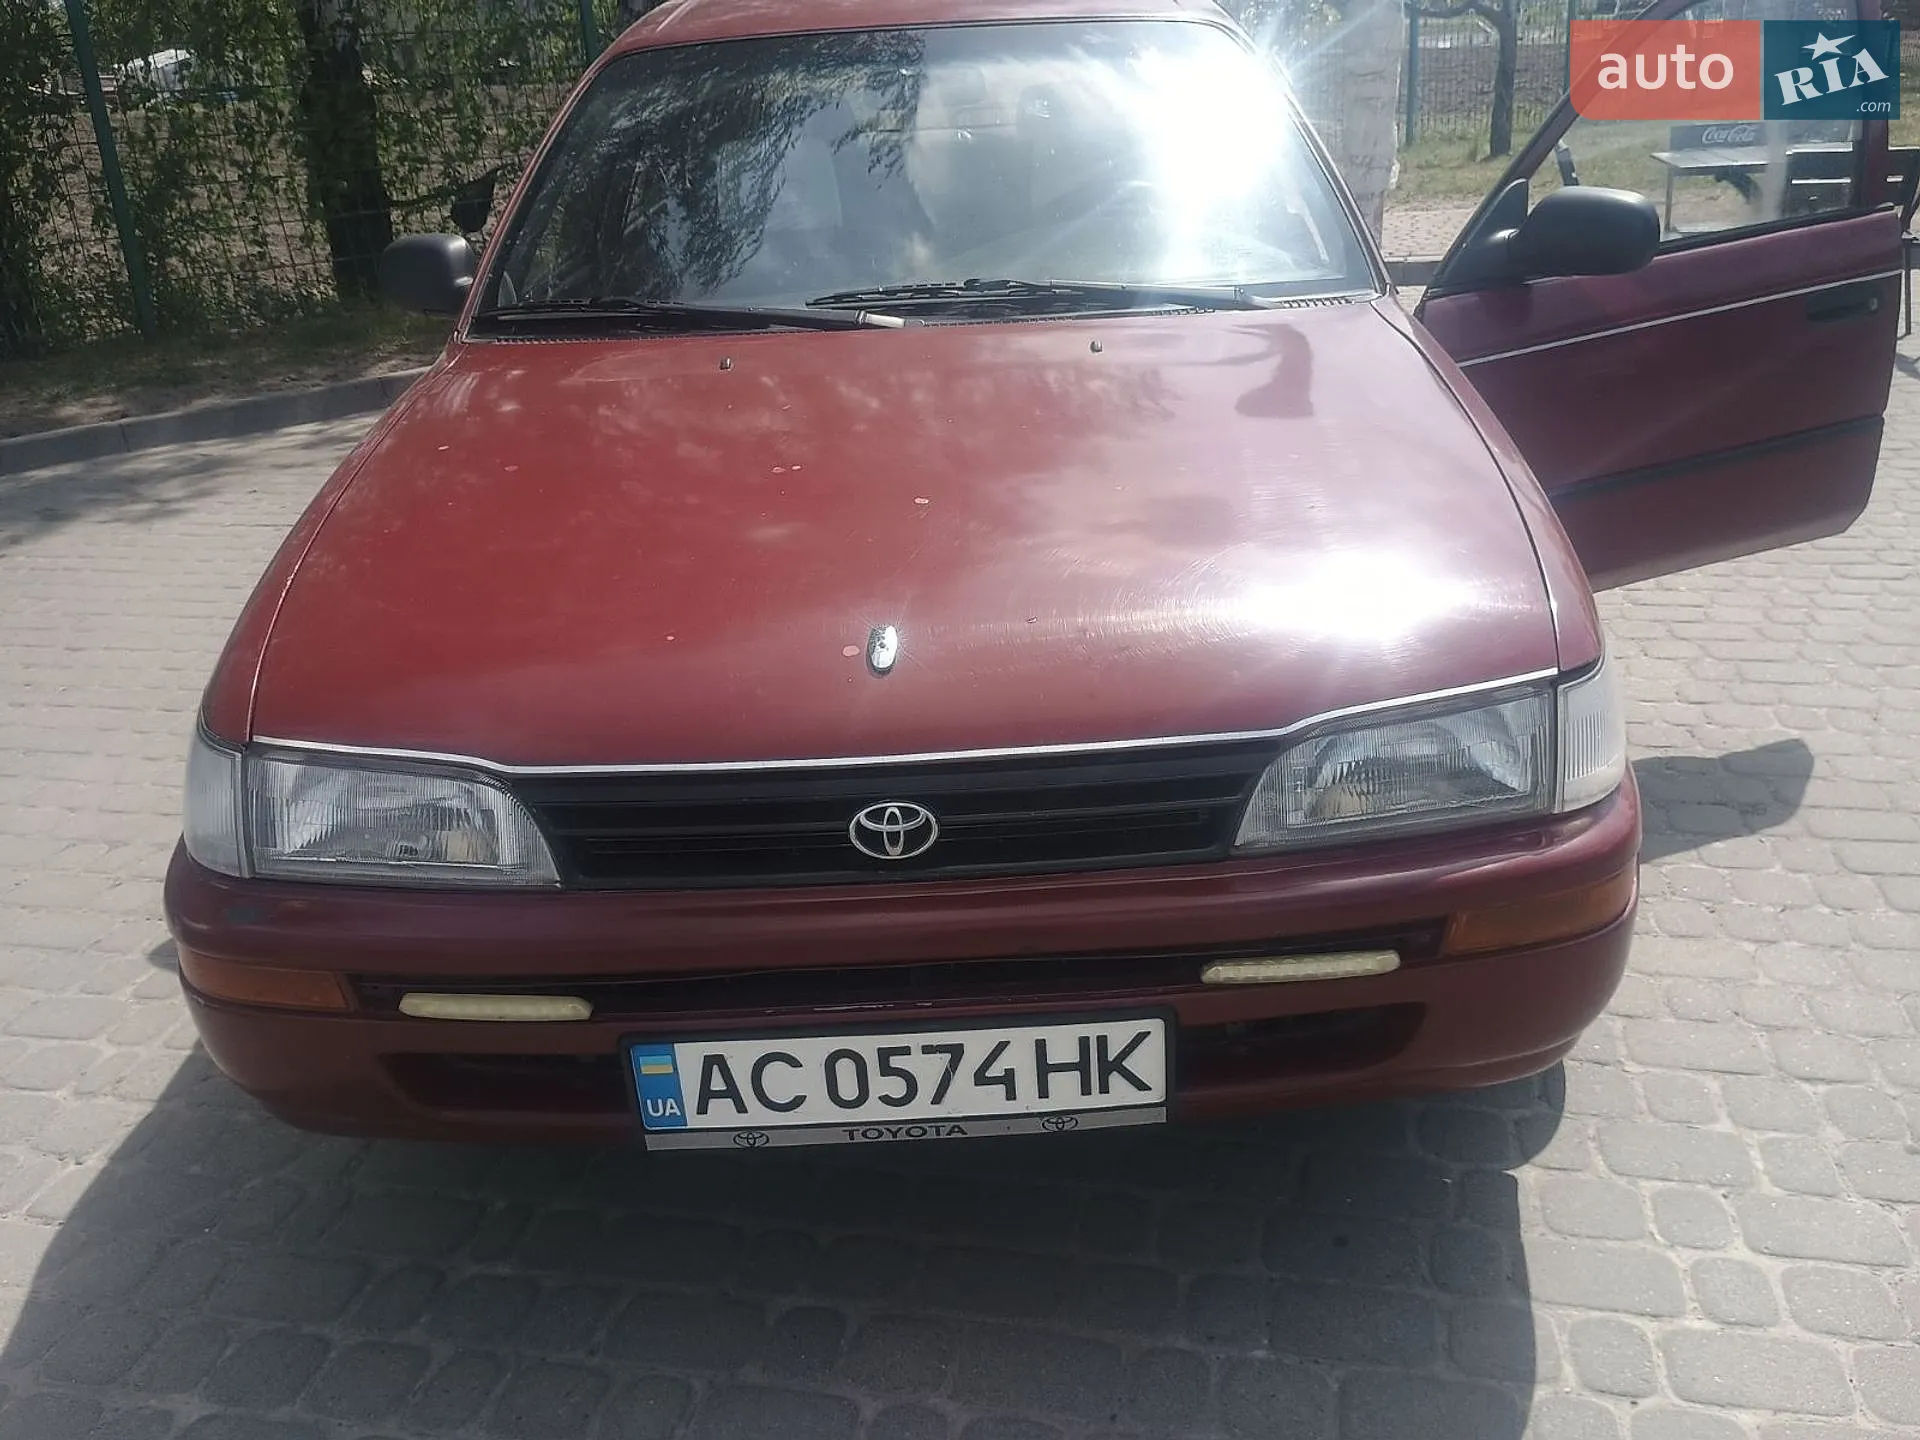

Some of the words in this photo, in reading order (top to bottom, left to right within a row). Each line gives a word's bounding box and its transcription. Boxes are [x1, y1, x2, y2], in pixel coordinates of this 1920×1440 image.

[696, 1050, 807, 1115] AC
[824, 1039, 1017, 1110] 0574
[1035, 1030, 1152, 1098] HK
[647, 1098, 681, 1117] UA
[842, 1124, 968, 1141] TOYOTA
